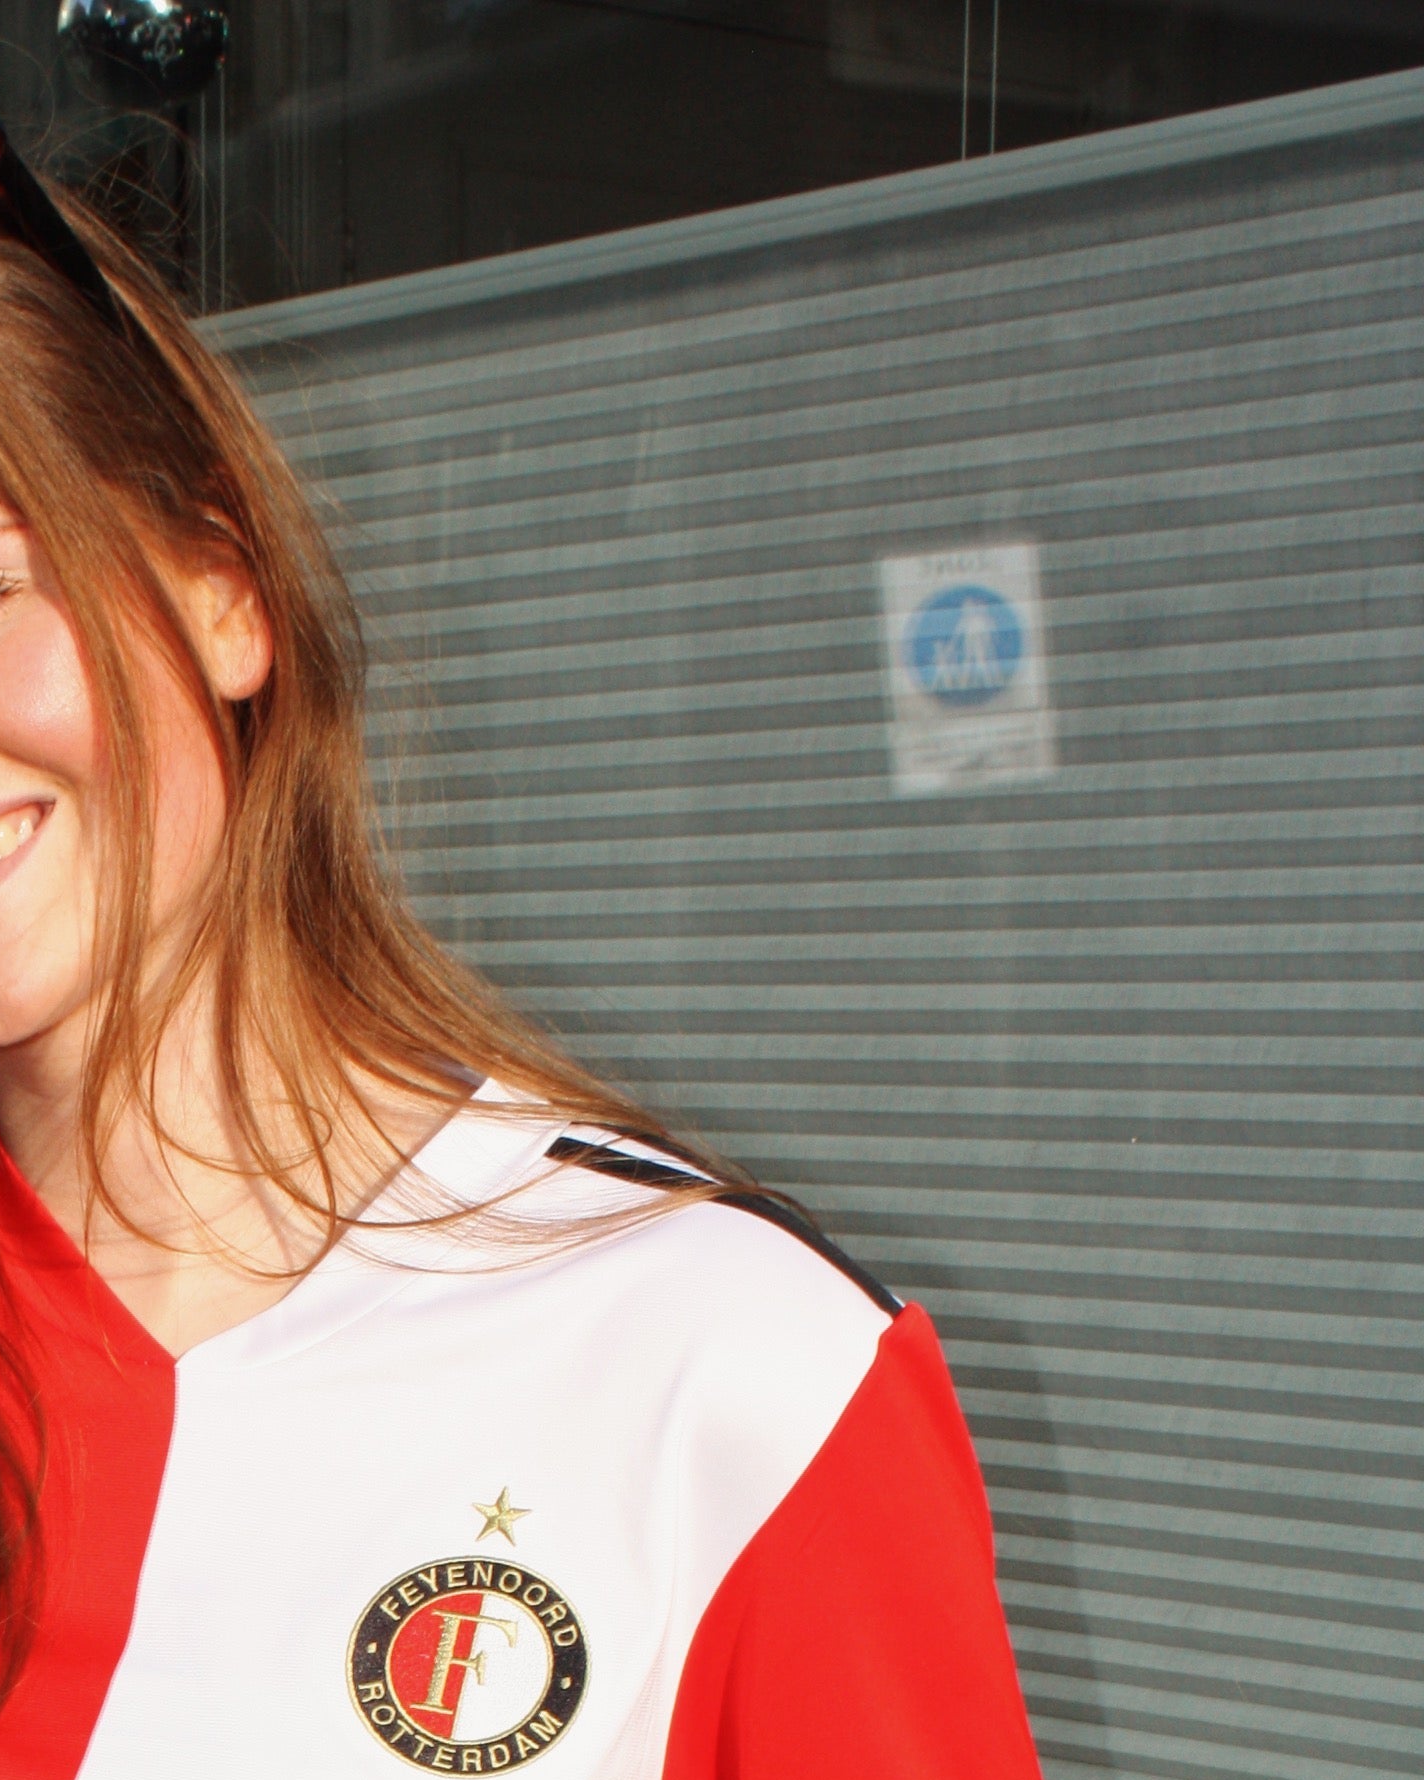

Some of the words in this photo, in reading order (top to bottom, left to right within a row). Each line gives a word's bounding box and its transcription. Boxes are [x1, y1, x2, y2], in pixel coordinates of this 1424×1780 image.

[379, 1561, 579, 1648] FEYENOORD
[409, 1609, 519, 1715] F
[357, 1679, 564, 1772] ROTTERDAM
